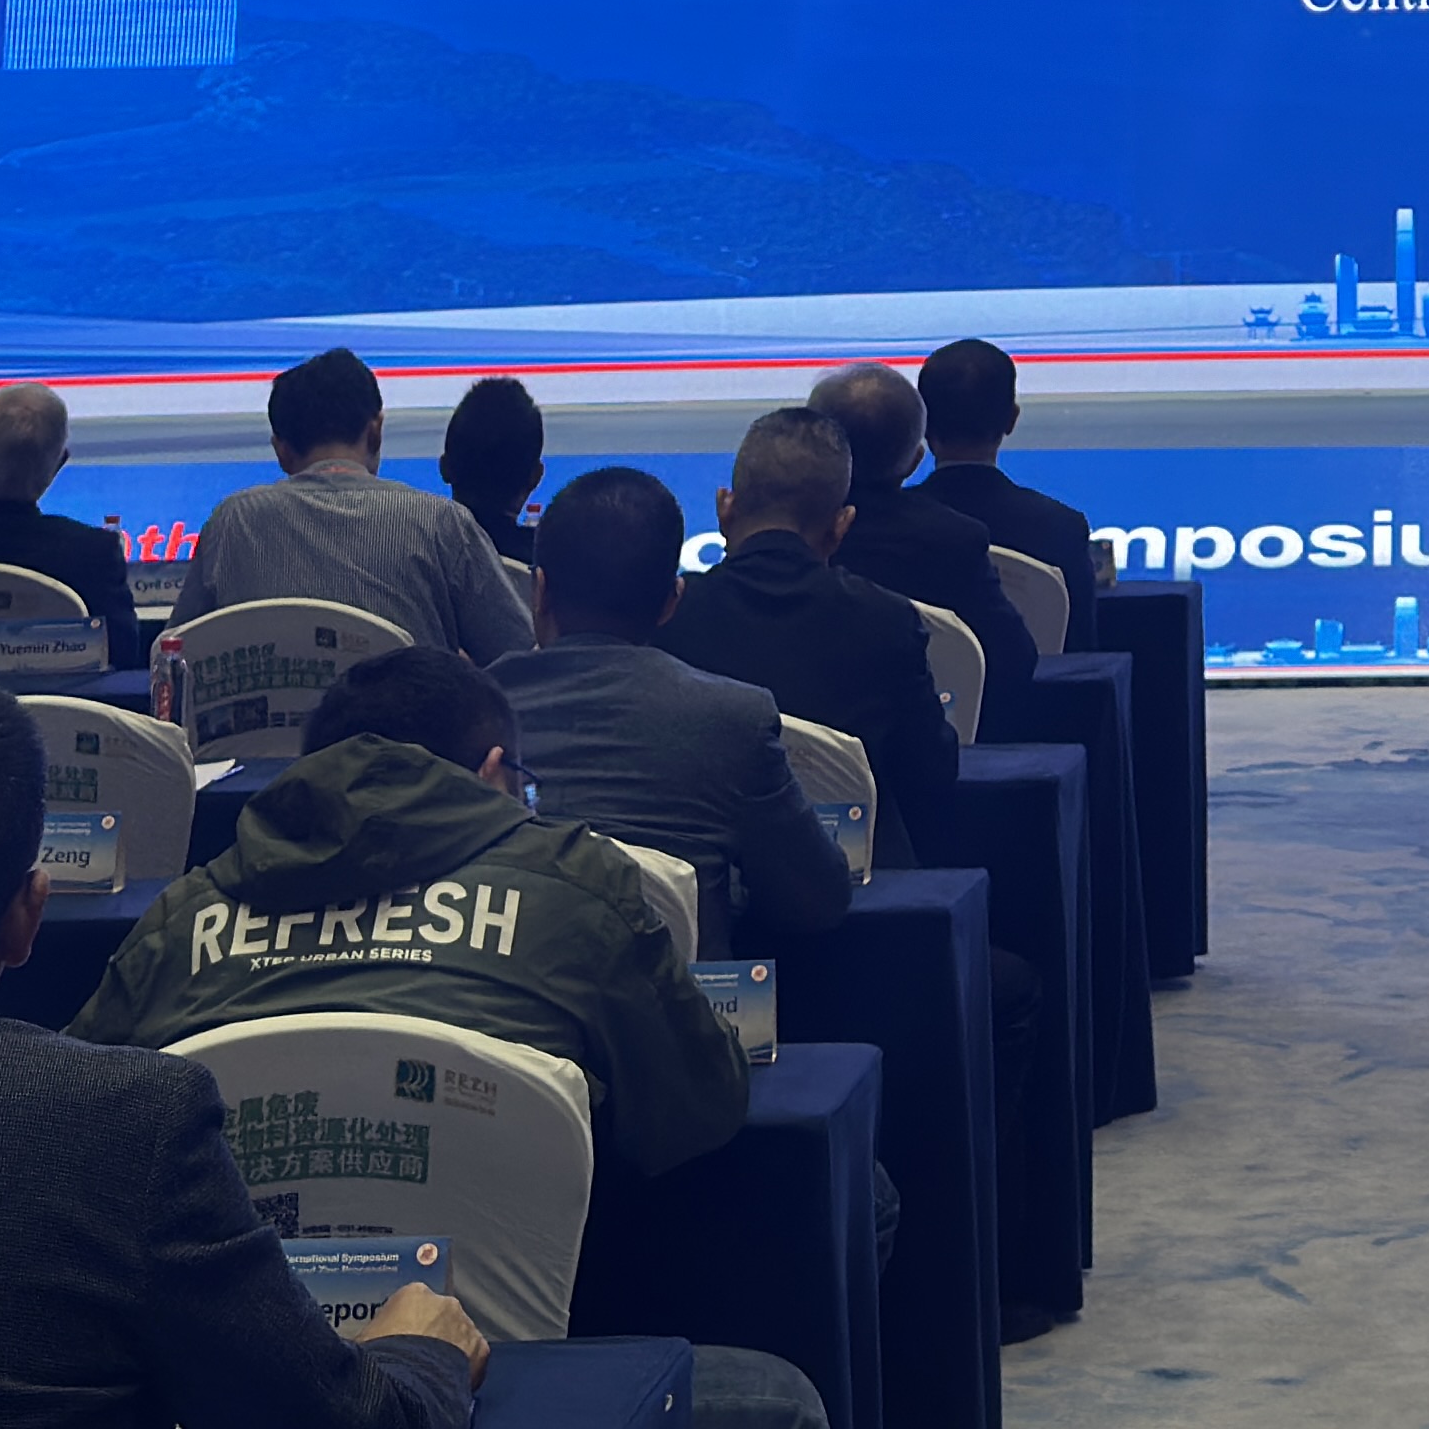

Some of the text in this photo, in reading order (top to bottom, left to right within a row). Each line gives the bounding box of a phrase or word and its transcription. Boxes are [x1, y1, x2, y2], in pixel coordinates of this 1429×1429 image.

[40, 845, 91, 869] Zeng
[369, 947, 433, 963] SERIES
[247, 1148, 424, 1180] 决方案供应商
[287, 1253, 339, 1264] ernational
[321, 1298, 389, 1328] epor
